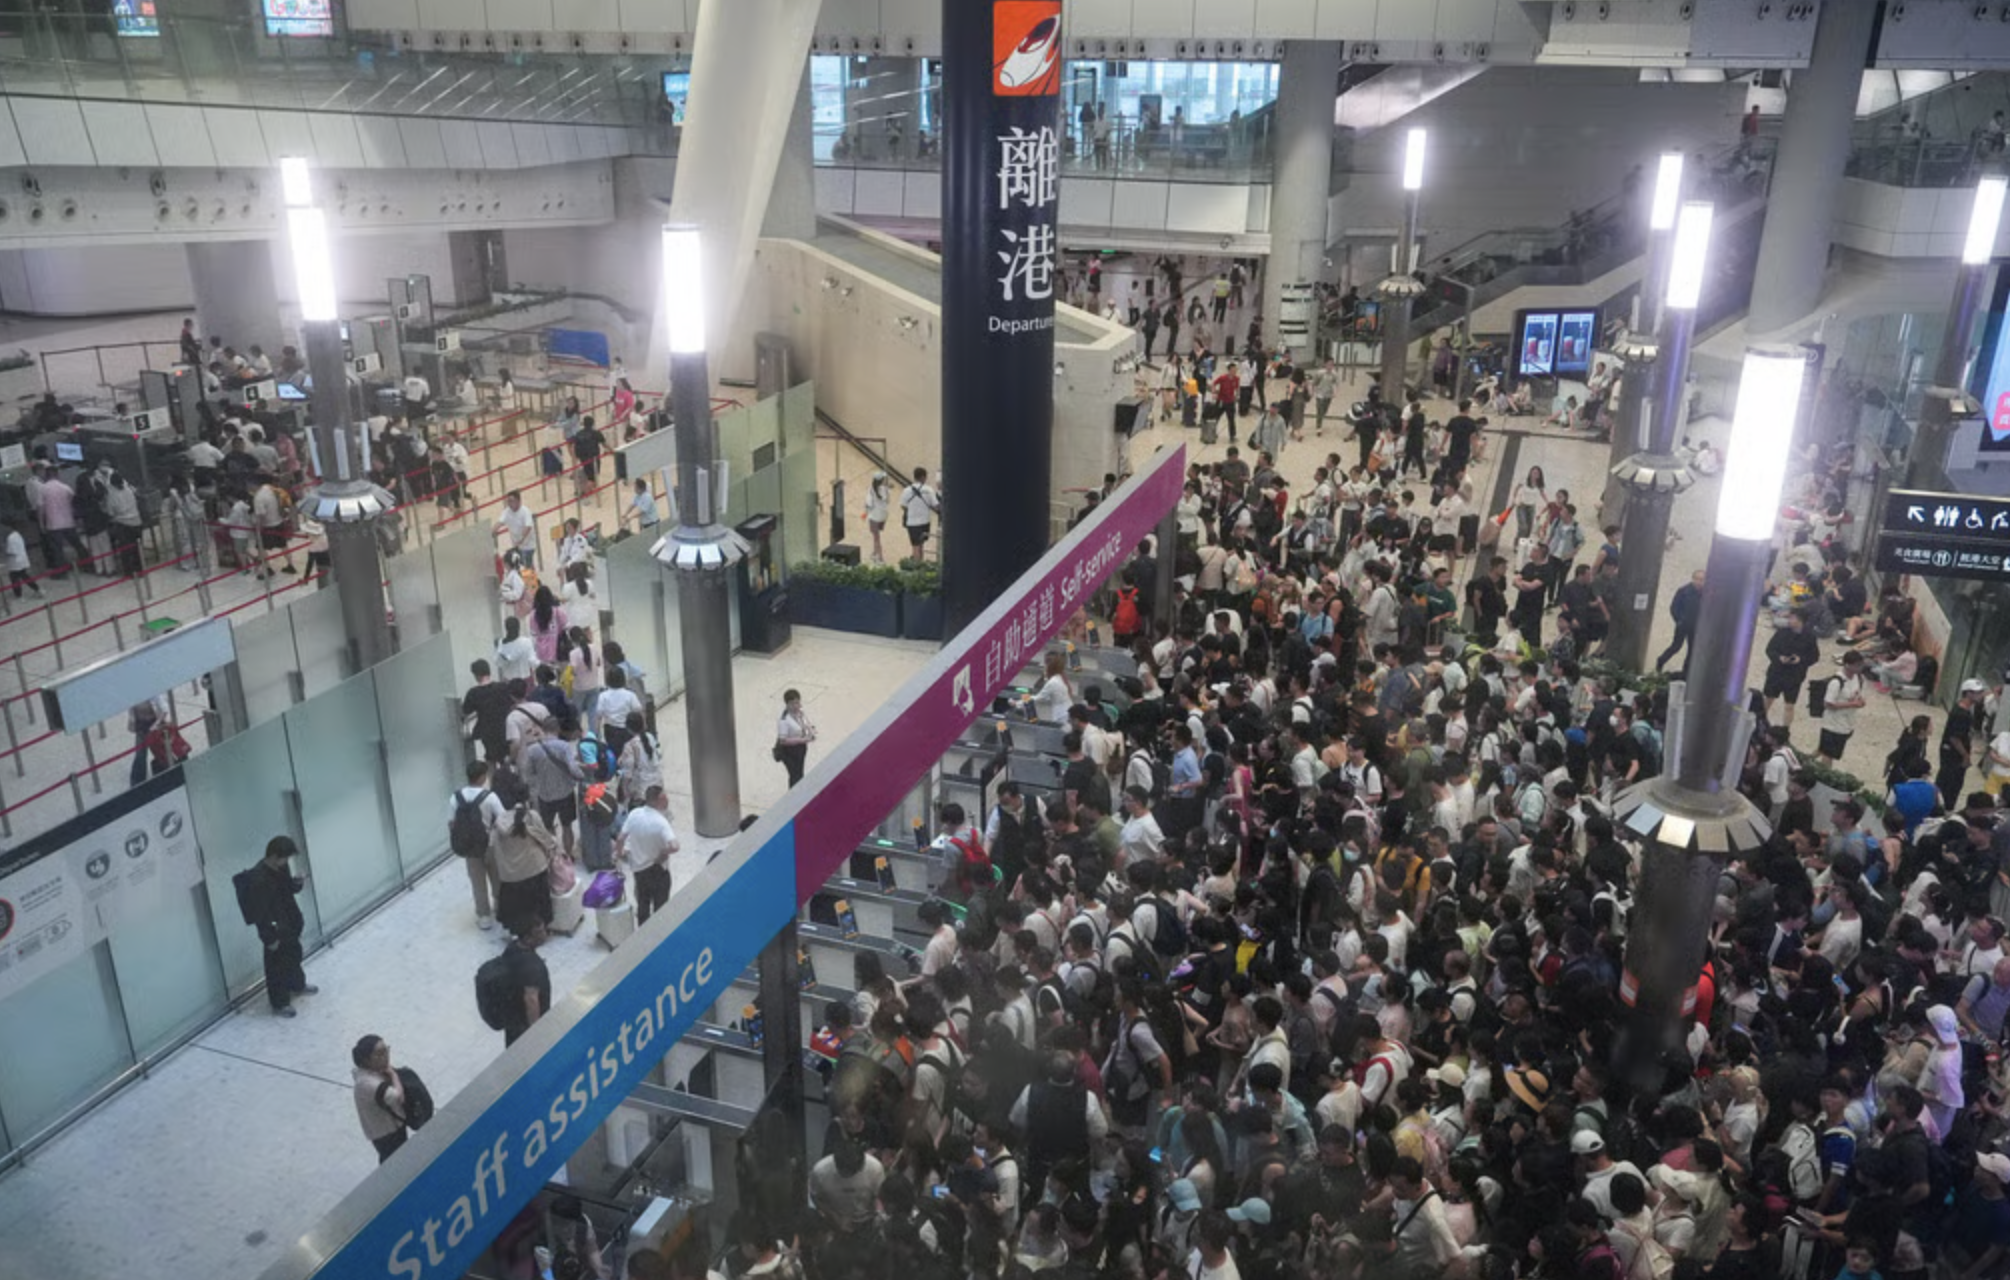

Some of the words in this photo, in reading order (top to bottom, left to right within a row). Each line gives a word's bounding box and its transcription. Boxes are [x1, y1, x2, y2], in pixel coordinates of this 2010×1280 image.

[997, 125, 1056, 301] 離港
[989, 315, 1054, 334] Departu
[986, 583, 1055, 693] 自助通道
[1060, 531, 1123, 610] Self-service
[387, 1132, 510, 1280] Staff
[522, 947, 713, 1168] assistance
